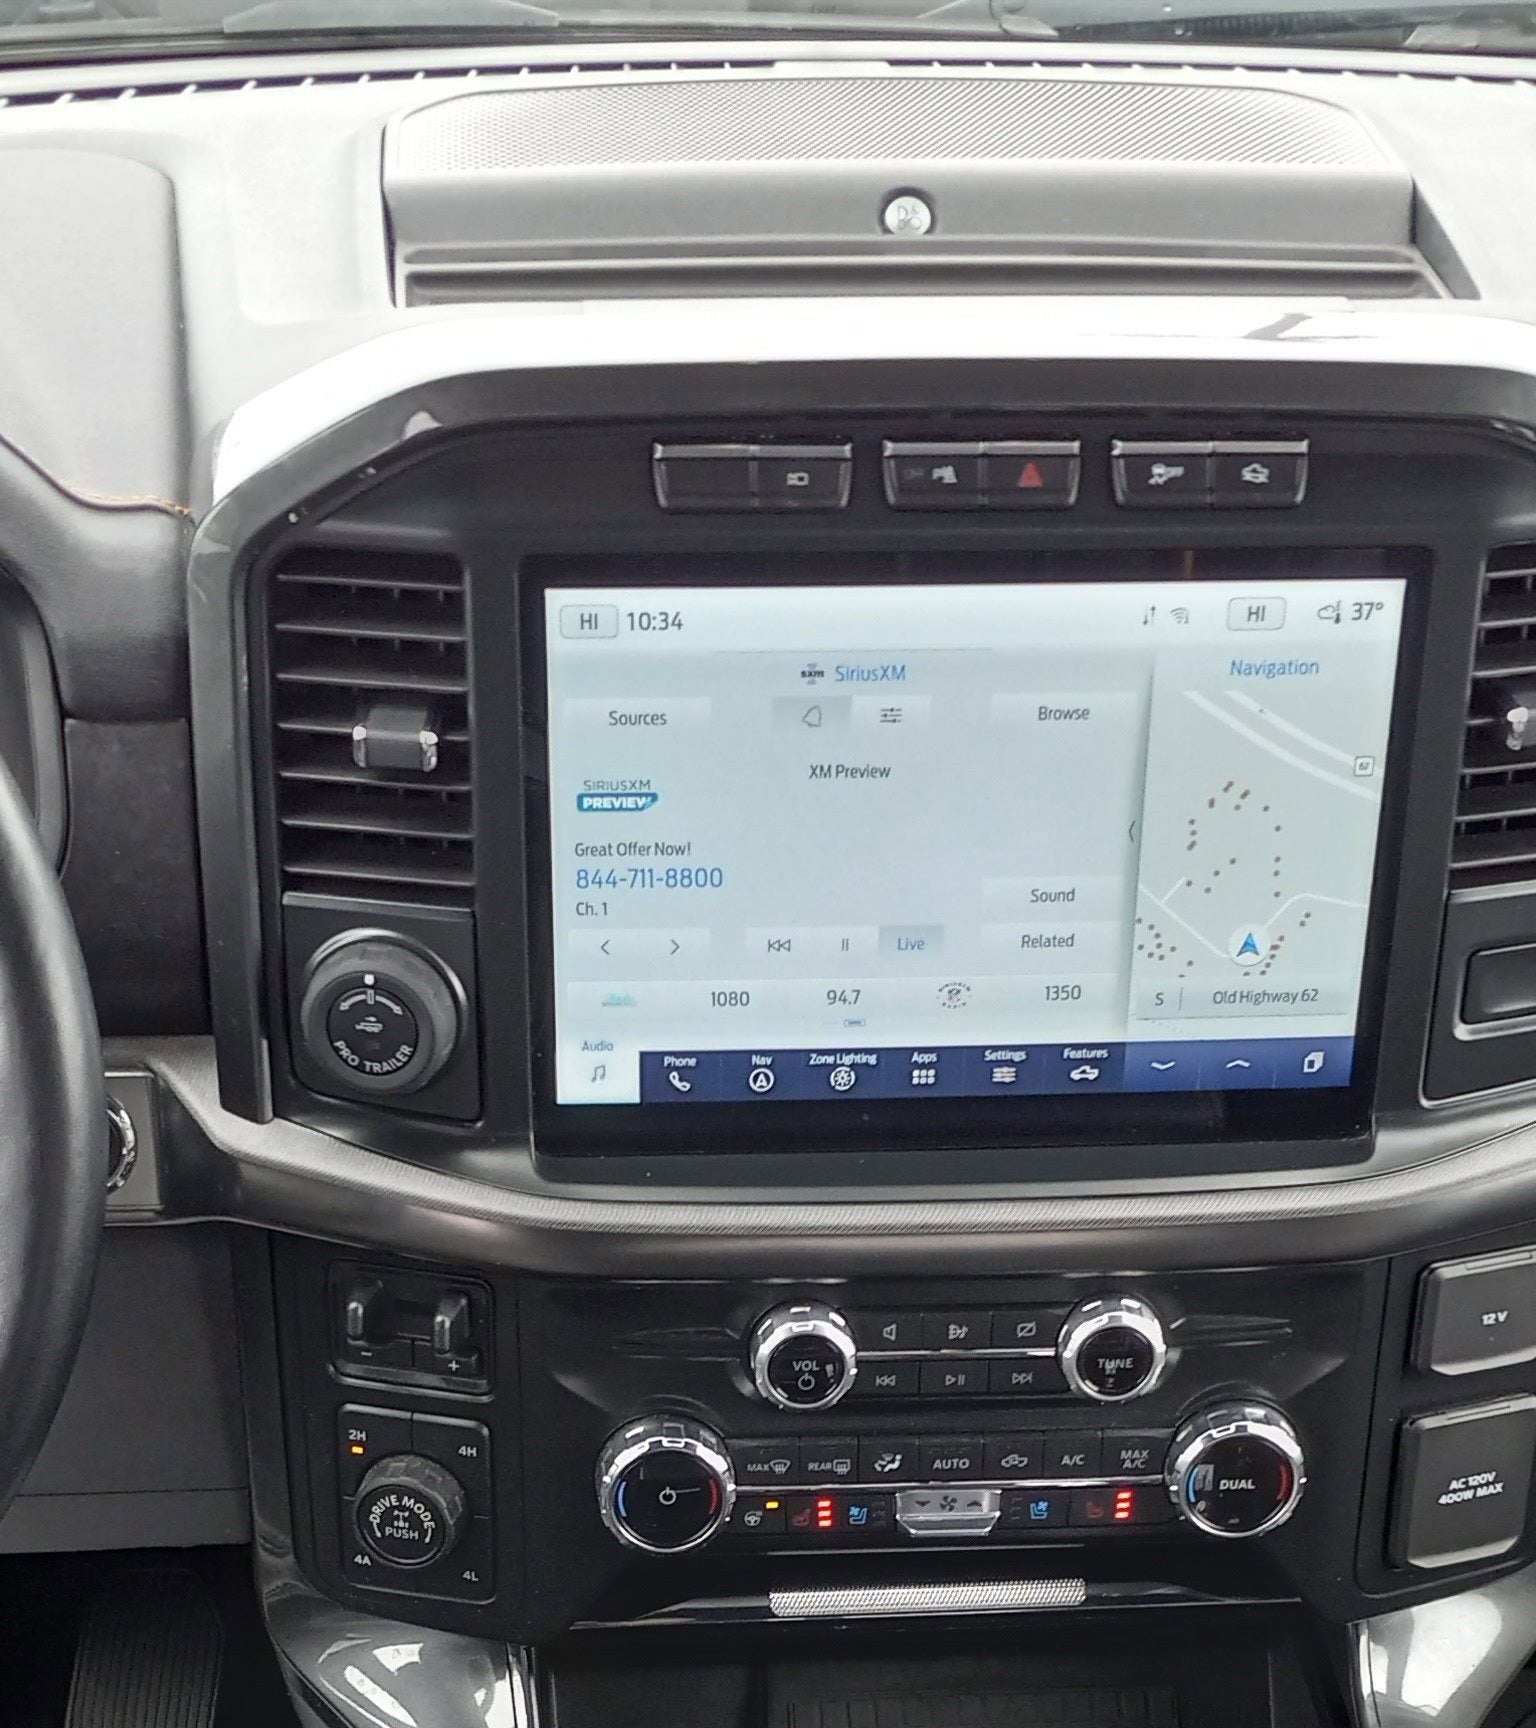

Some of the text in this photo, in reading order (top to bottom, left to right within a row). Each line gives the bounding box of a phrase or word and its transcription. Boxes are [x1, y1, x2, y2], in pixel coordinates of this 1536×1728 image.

[1246, 605, 1266, 622] HI
[1350, 602, 1384, 621] 37°
[580, 611, 684, 632] HI 10:34
[835, 665, 907, 684] SiriusXM
[1230, 659, 1320, 679] Navigation
[608, 709, 667, 727] Sources
[1038, 705, 1090, 722] Browse
[809, 763, 891, 781] XM Preview
[583, 779, 651, 792] SIRIUSXM
[581, 796, 648, 811] PREVIEW
[574, 841, 692, 858] Great Offer Now!
[575, 866, 724, 890] 844-711-8800
[1030, 887, 1076, 904] Sound
[575, 901, 608, 917] Ch. 1
[897, 935, 926, 952] Live
[1020, 933, 1075, 950] Related
[710, 991, 751, 1007] 1080
[826, 989, 861, 1006] 94.7
[1045, 984, 1082, 1001] 1350
[1154, 991, 1164, 1006] S
[1212, 988, 1319, 1006] Old Highway 62
[582, 1039, 614, 1053] Audio
[1063, 1046, 1109, 1060] Features
[333, 1040, 414, 1074] PRO TRAILER
[664, 1055, 697, 1069] Phone
[751, 1054, 773, 1067] Nav
[809, 1051, 877, 1067] Zone Lighting
[911, 1051, 938, 1067] Apps
[984, 1048, 1027, 1064] Settings
[792, 1359, 820, 1372] VOL
[1097, 1357, 1134, 1369] TUNE
[348, 1428, 367, 1442] 2H
[457, 1445, 478, 1458] 4H
[1120, 1448, 1149, 1460] MAX
[746, 1461, 769, 1472] MAX
[807, 1461, 832, 1472] REAR
[932, 1457, 970, 1470] AUTO
[1061, 1453, 1086, 1467] A/C
[1122, 1458, 1147, 1470] A/C
[1218, 1478, 1256, 1491] DUAL
[1448, 1471, 1497, 1491] AC 120V
[1437, 1482, 1504, 1506] 400W MAX
[368, 1494, 436, 1530] DRIVE MODE
[385, 1527, 419, 1540] PUSH
[353, 1554, 372, 1567] 4A
[462, 1571, 480, 1582] 4L
